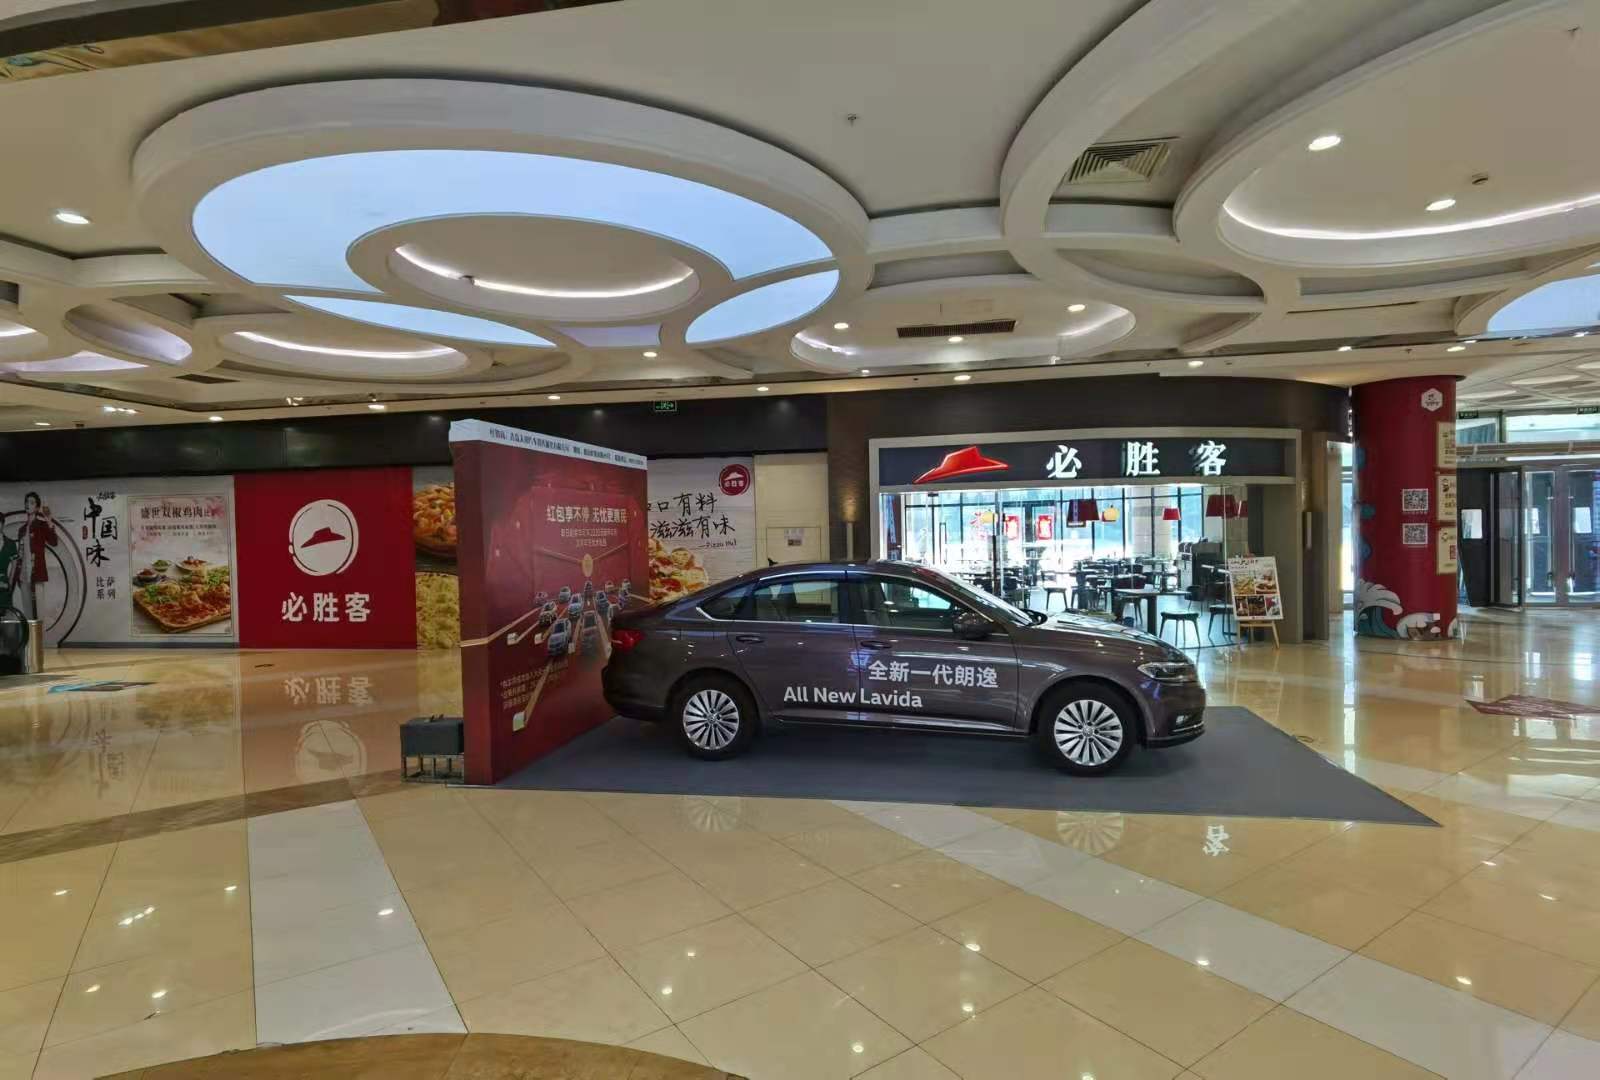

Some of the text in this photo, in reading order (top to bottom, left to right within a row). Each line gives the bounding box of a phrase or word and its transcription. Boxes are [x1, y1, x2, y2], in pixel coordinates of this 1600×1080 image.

[1046, 440, 1227, 479] 必胜客
[647, 492, 717, 517] 口有料
[650, 514, 736, 540] 滋滋有味
[281, 591, 371, 622] 必胜客
[868, 660, 999, 688] 全新一代朗逸
[783, 686, 923, 708] All New Lavida
